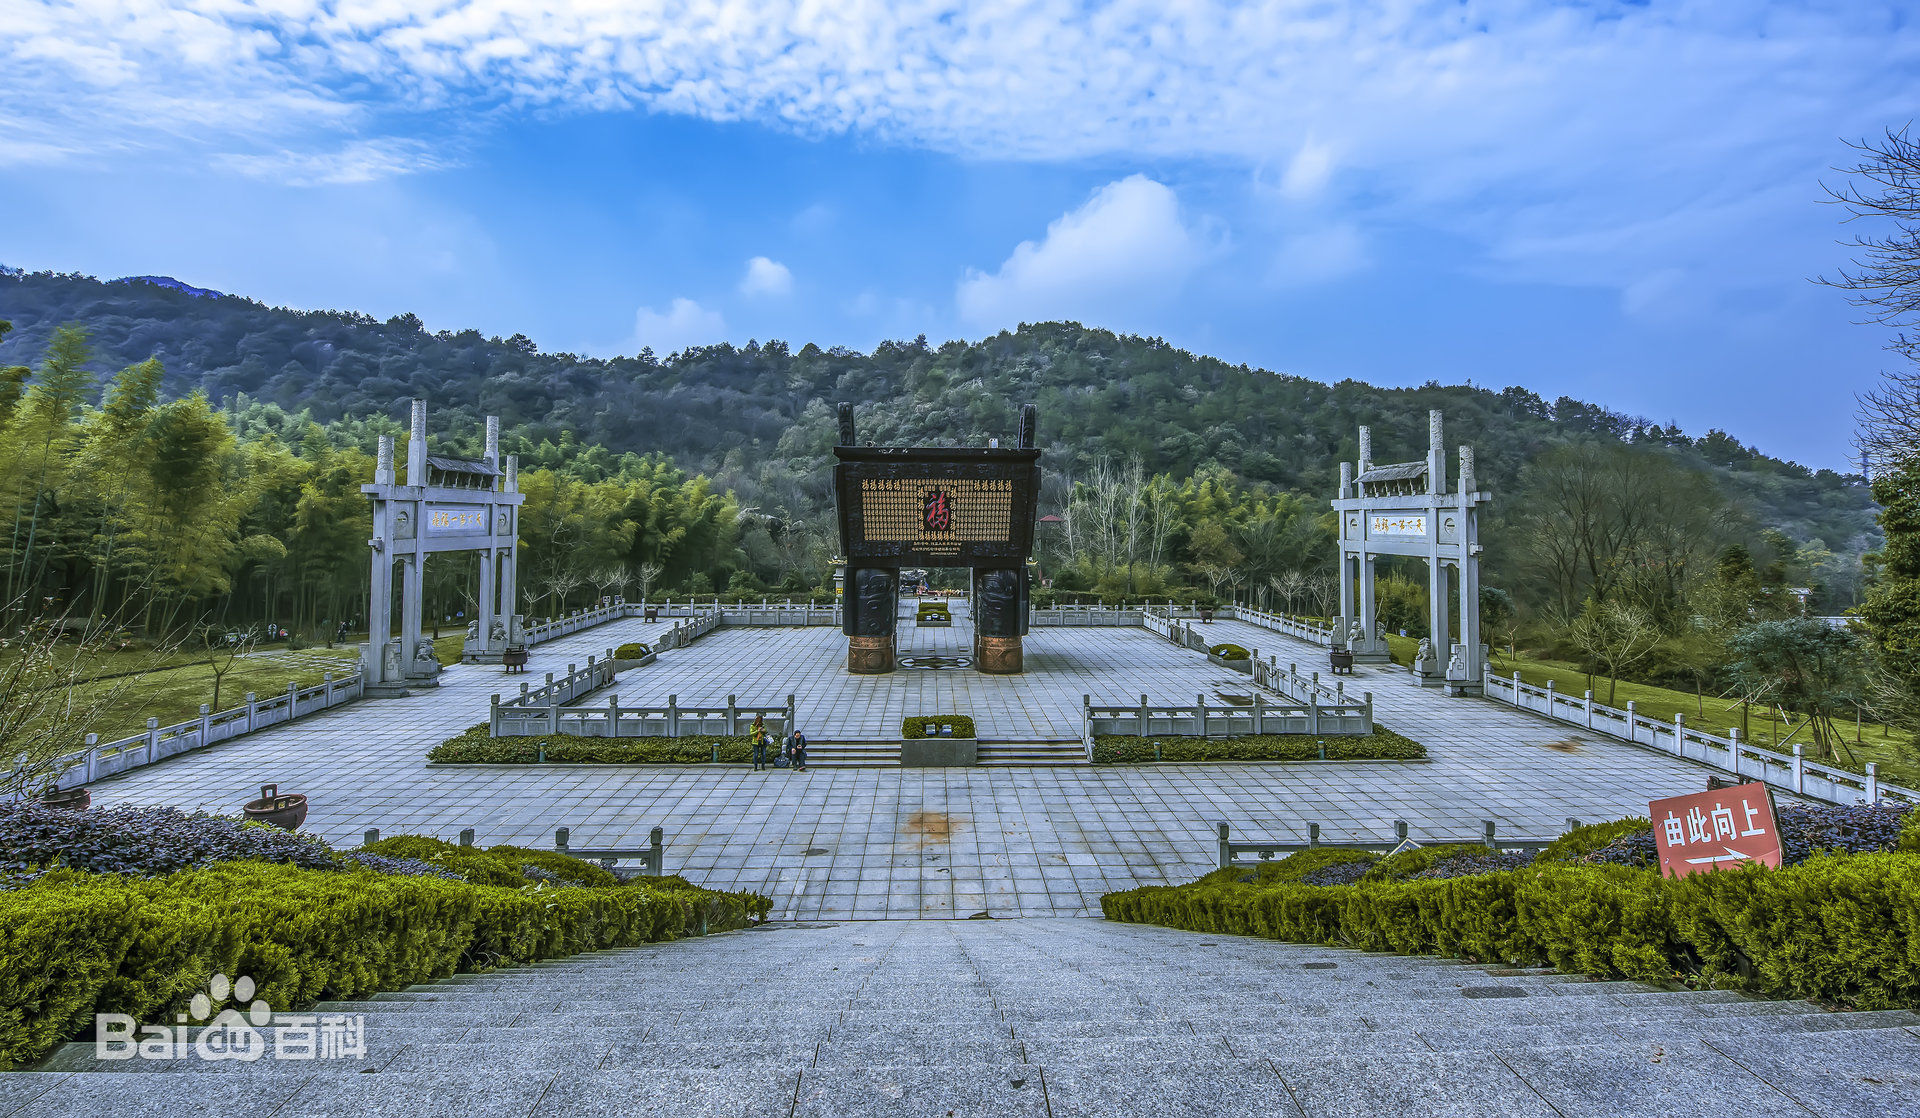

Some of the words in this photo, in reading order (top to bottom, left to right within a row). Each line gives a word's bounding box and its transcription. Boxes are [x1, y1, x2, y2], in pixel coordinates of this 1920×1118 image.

[926, 491, 949, 530] 福
[1663, 799, 1766, 848] 由此向上
